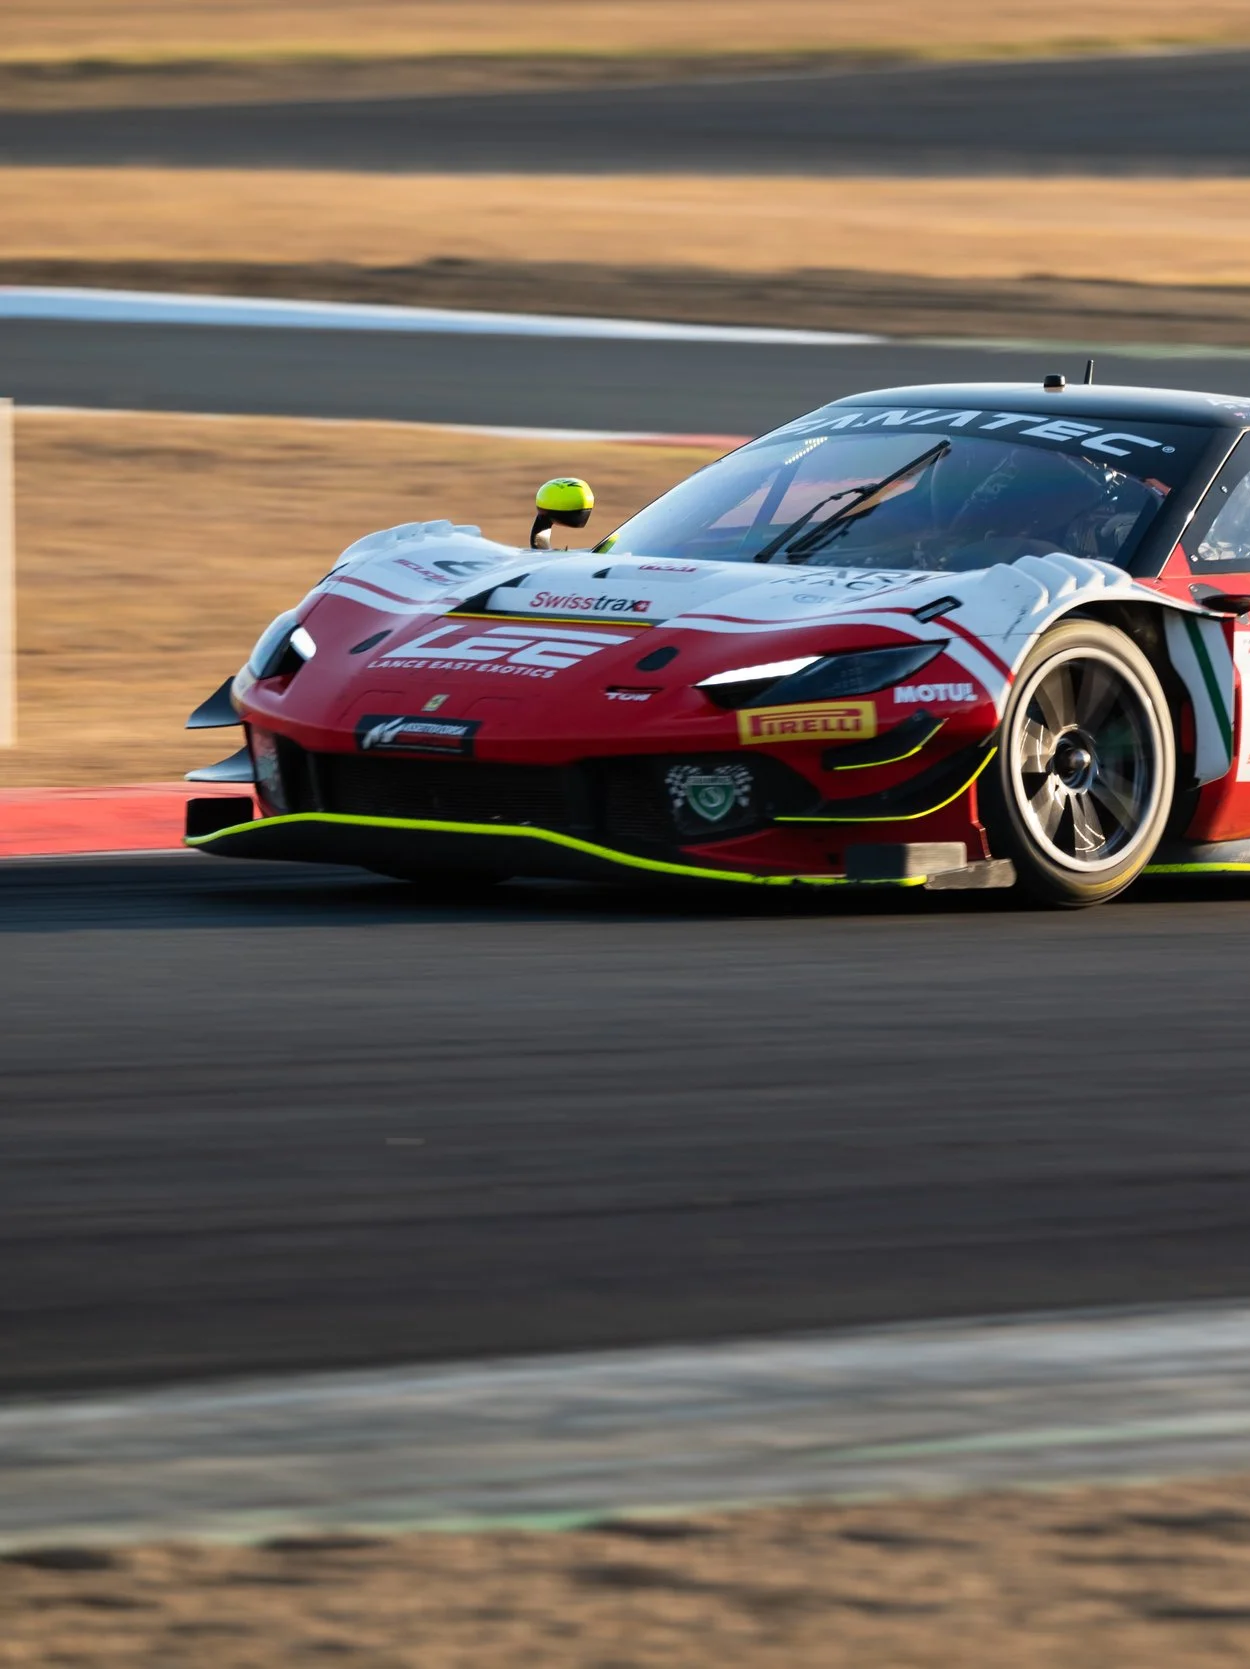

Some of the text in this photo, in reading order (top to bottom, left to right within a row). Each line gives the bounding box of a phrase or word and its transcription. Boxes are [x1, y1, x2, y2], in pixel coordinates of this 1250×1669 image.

[529, 591, 641, 612] Swisstrax
[380, 624, 636, 669] LEE
[367, 659, 558, 679] LANCE EAST EXOTICS
[894, 683, 978, 703] MOTUL
[748, 708, 863, 736] PIRELLI
